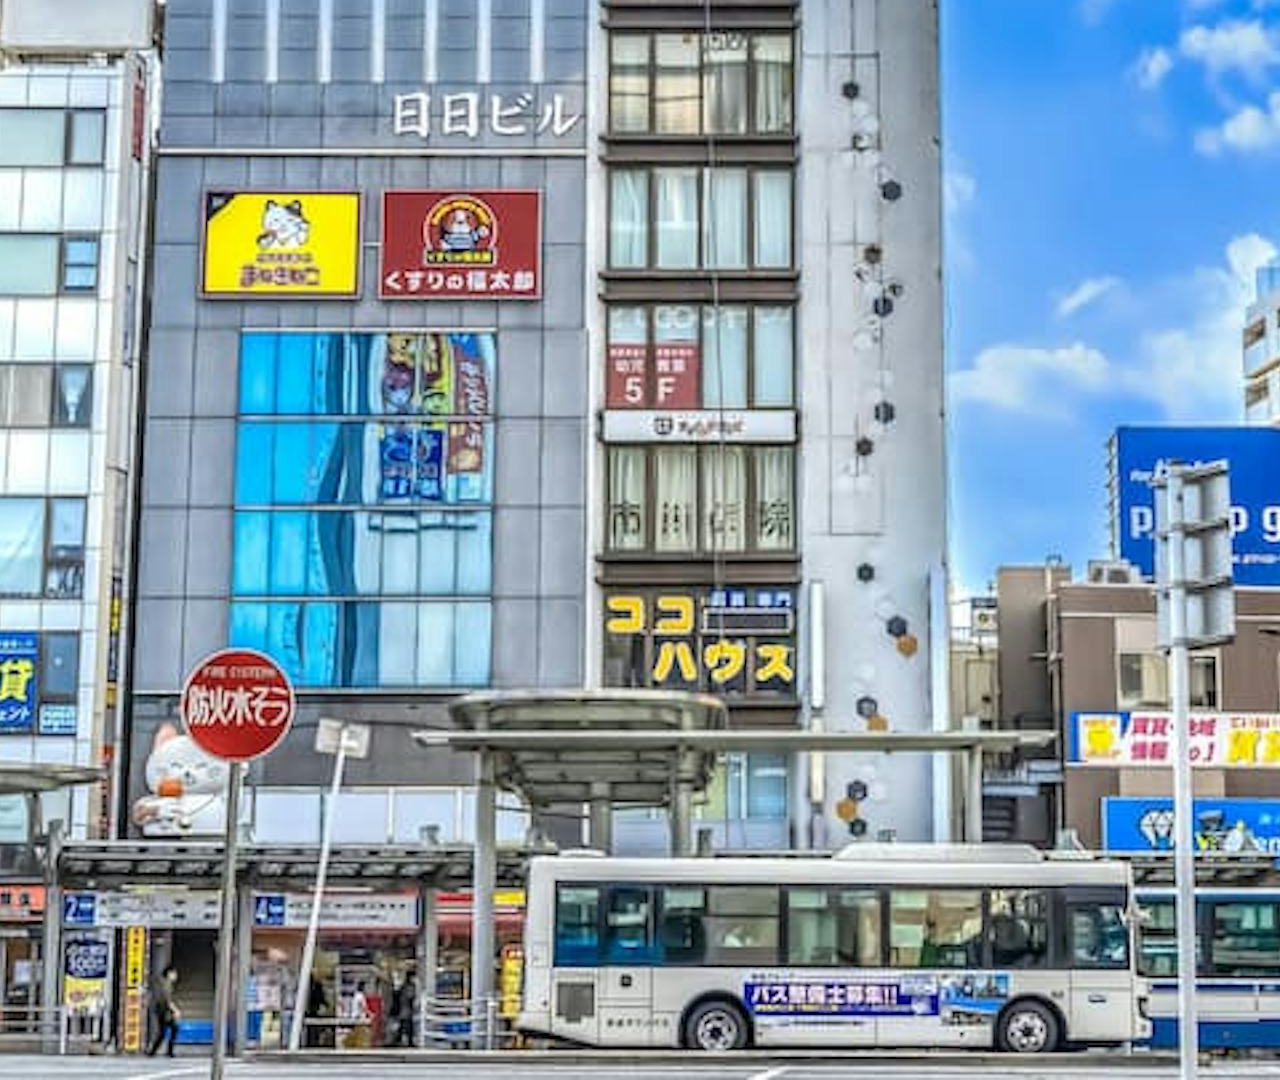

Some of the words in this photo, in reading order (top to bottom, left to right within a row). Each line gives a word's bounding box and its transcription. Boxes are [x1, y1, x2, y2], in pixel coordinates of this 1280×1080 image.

[394, 92, 581, 139] 日日ビル
[384, 270, 535, 291] くすりの福太郎
[607, 596, 696, 634] ココ
[653, 640, 795, 684] ハウス
[188, 685, 289, 727] 防火水そう
[64, 895, 79, 921] 2
[256, 896, 270, 921] 4
